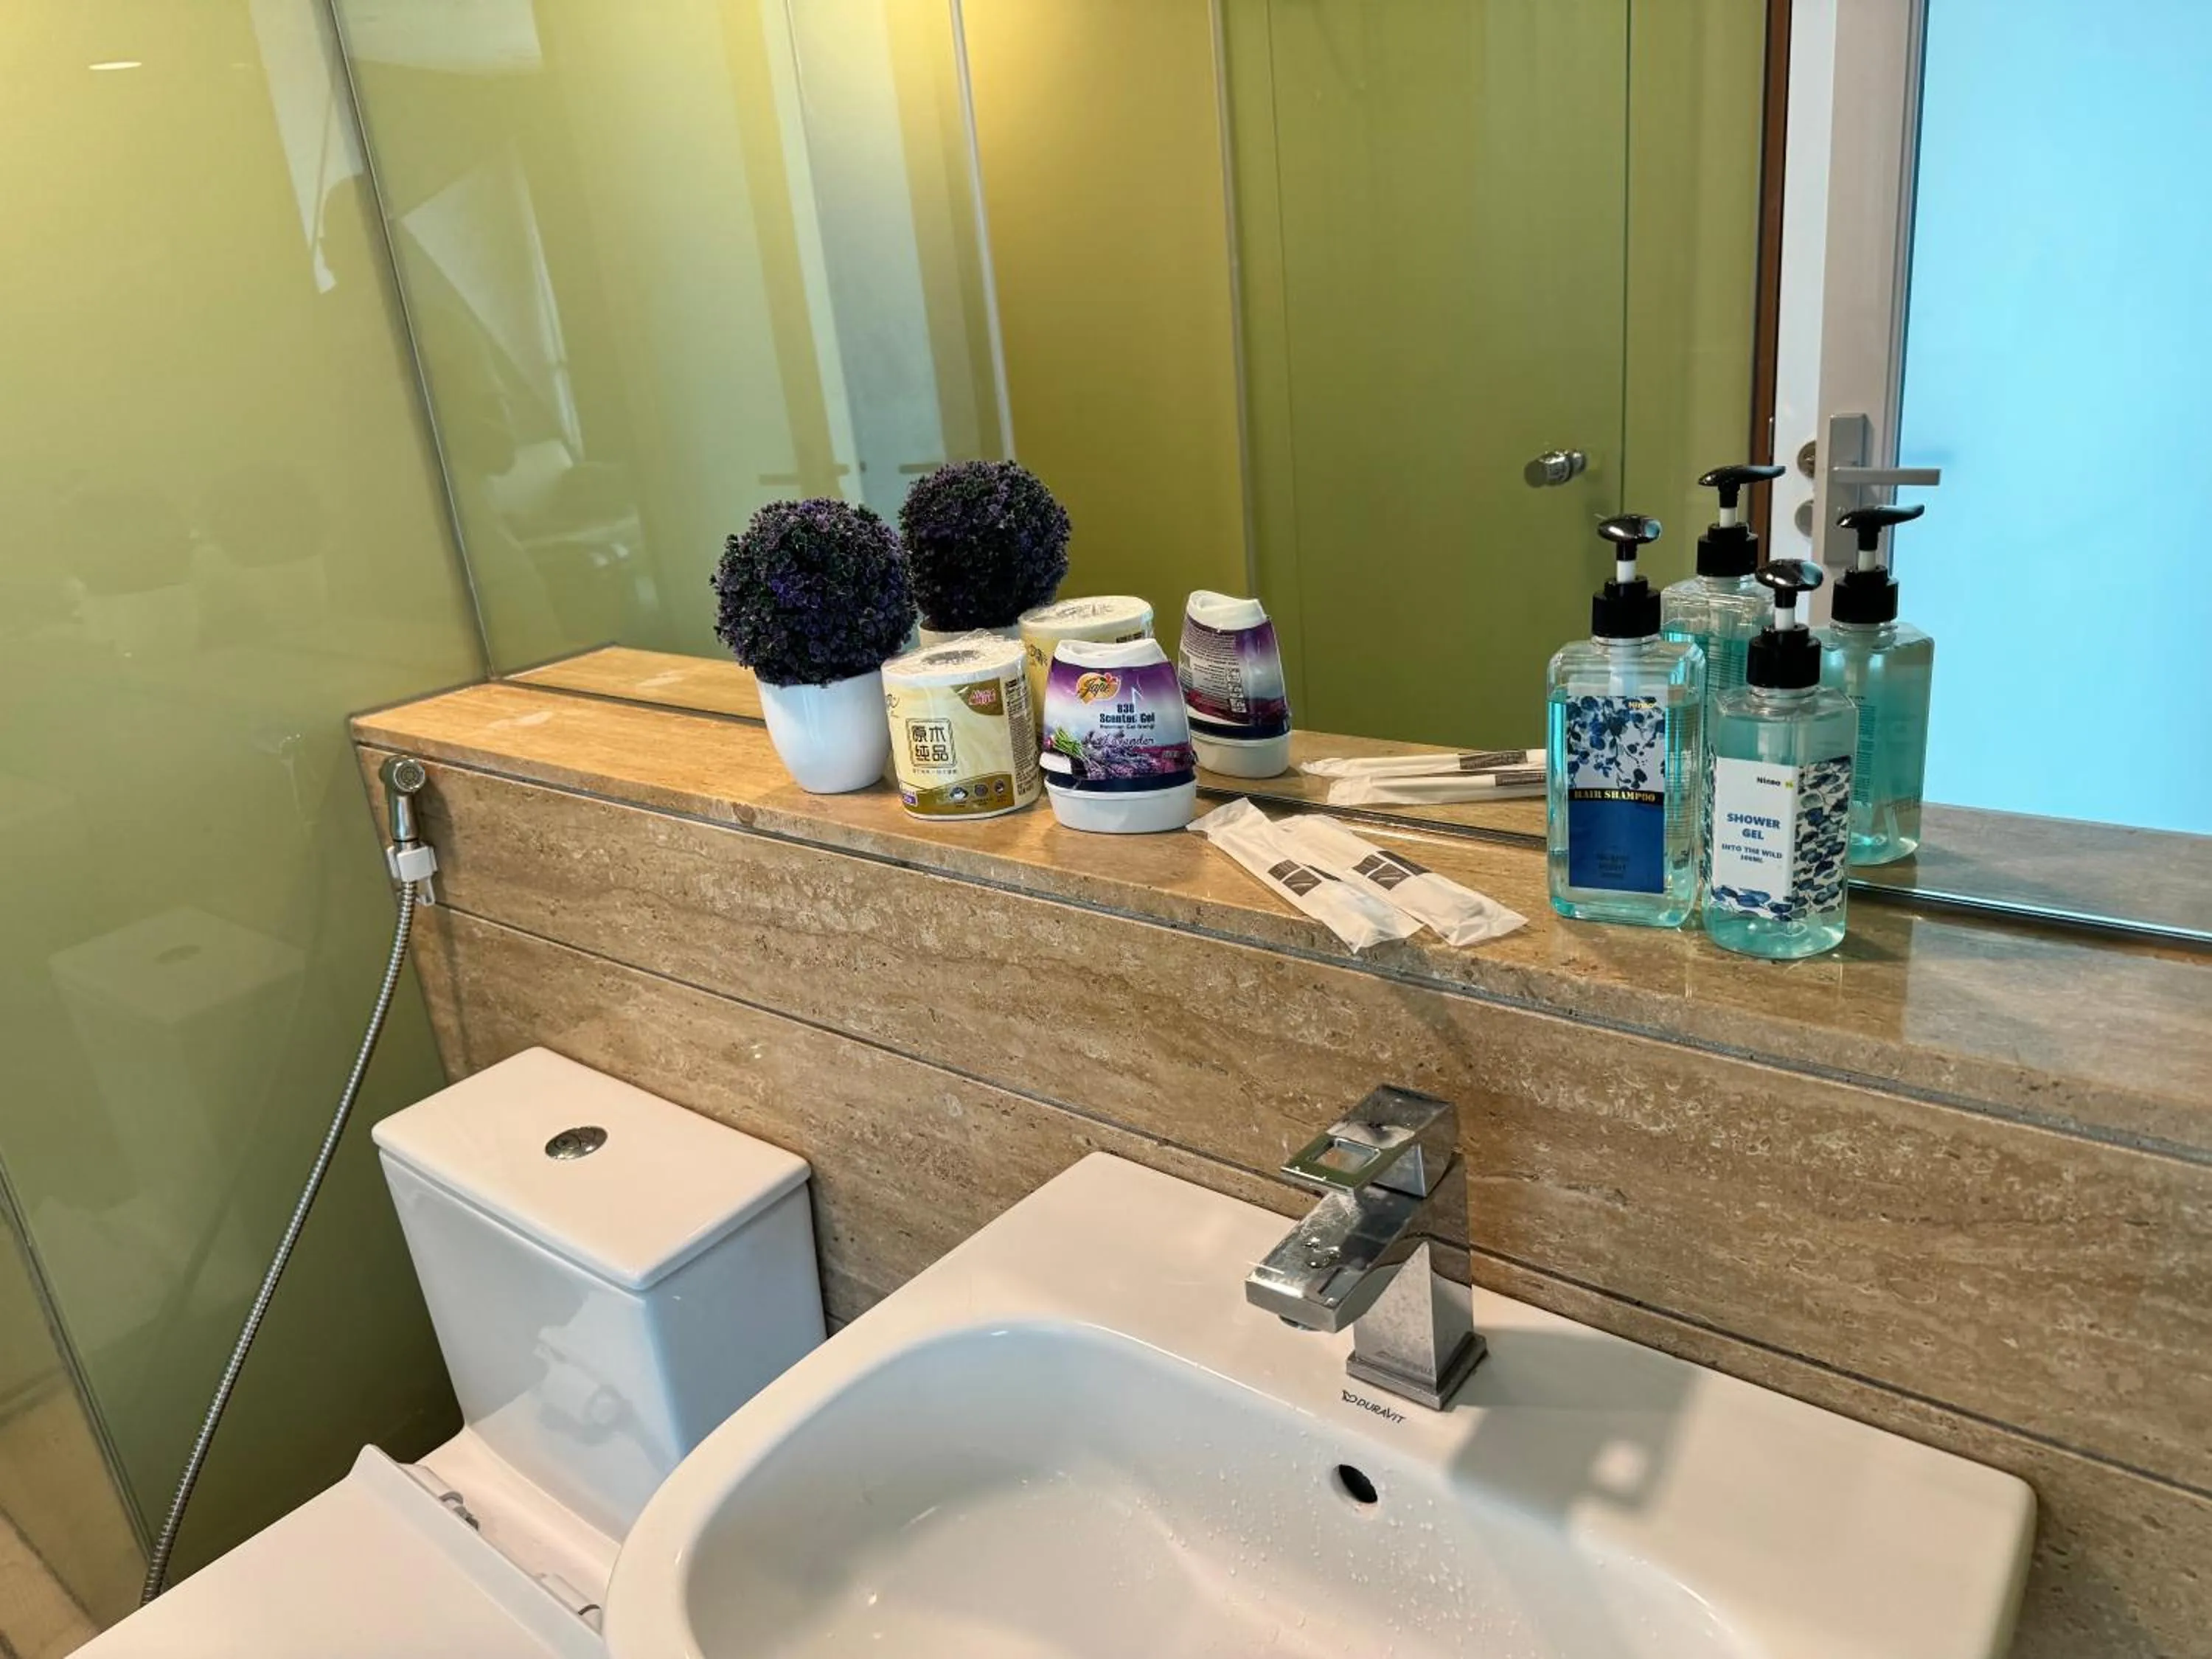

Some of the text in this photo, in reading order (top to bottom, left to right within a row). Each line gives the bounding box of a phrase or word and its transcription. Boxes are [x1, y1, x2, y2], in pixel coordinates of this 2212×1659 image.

[1141, 712, 1155, 723] Gel
[911, 726, 946, 742] 原木
[1574, 790, 1656, 803] HAIR SHAMPOO
[1726, 813, 1781, 830] SHOWER
[1742, 828, 1764, 840] GEL
[1722, 843, 1783, 859] INTO THE WILD
[1356, 1398, 1406, 1425] DURAVIT
